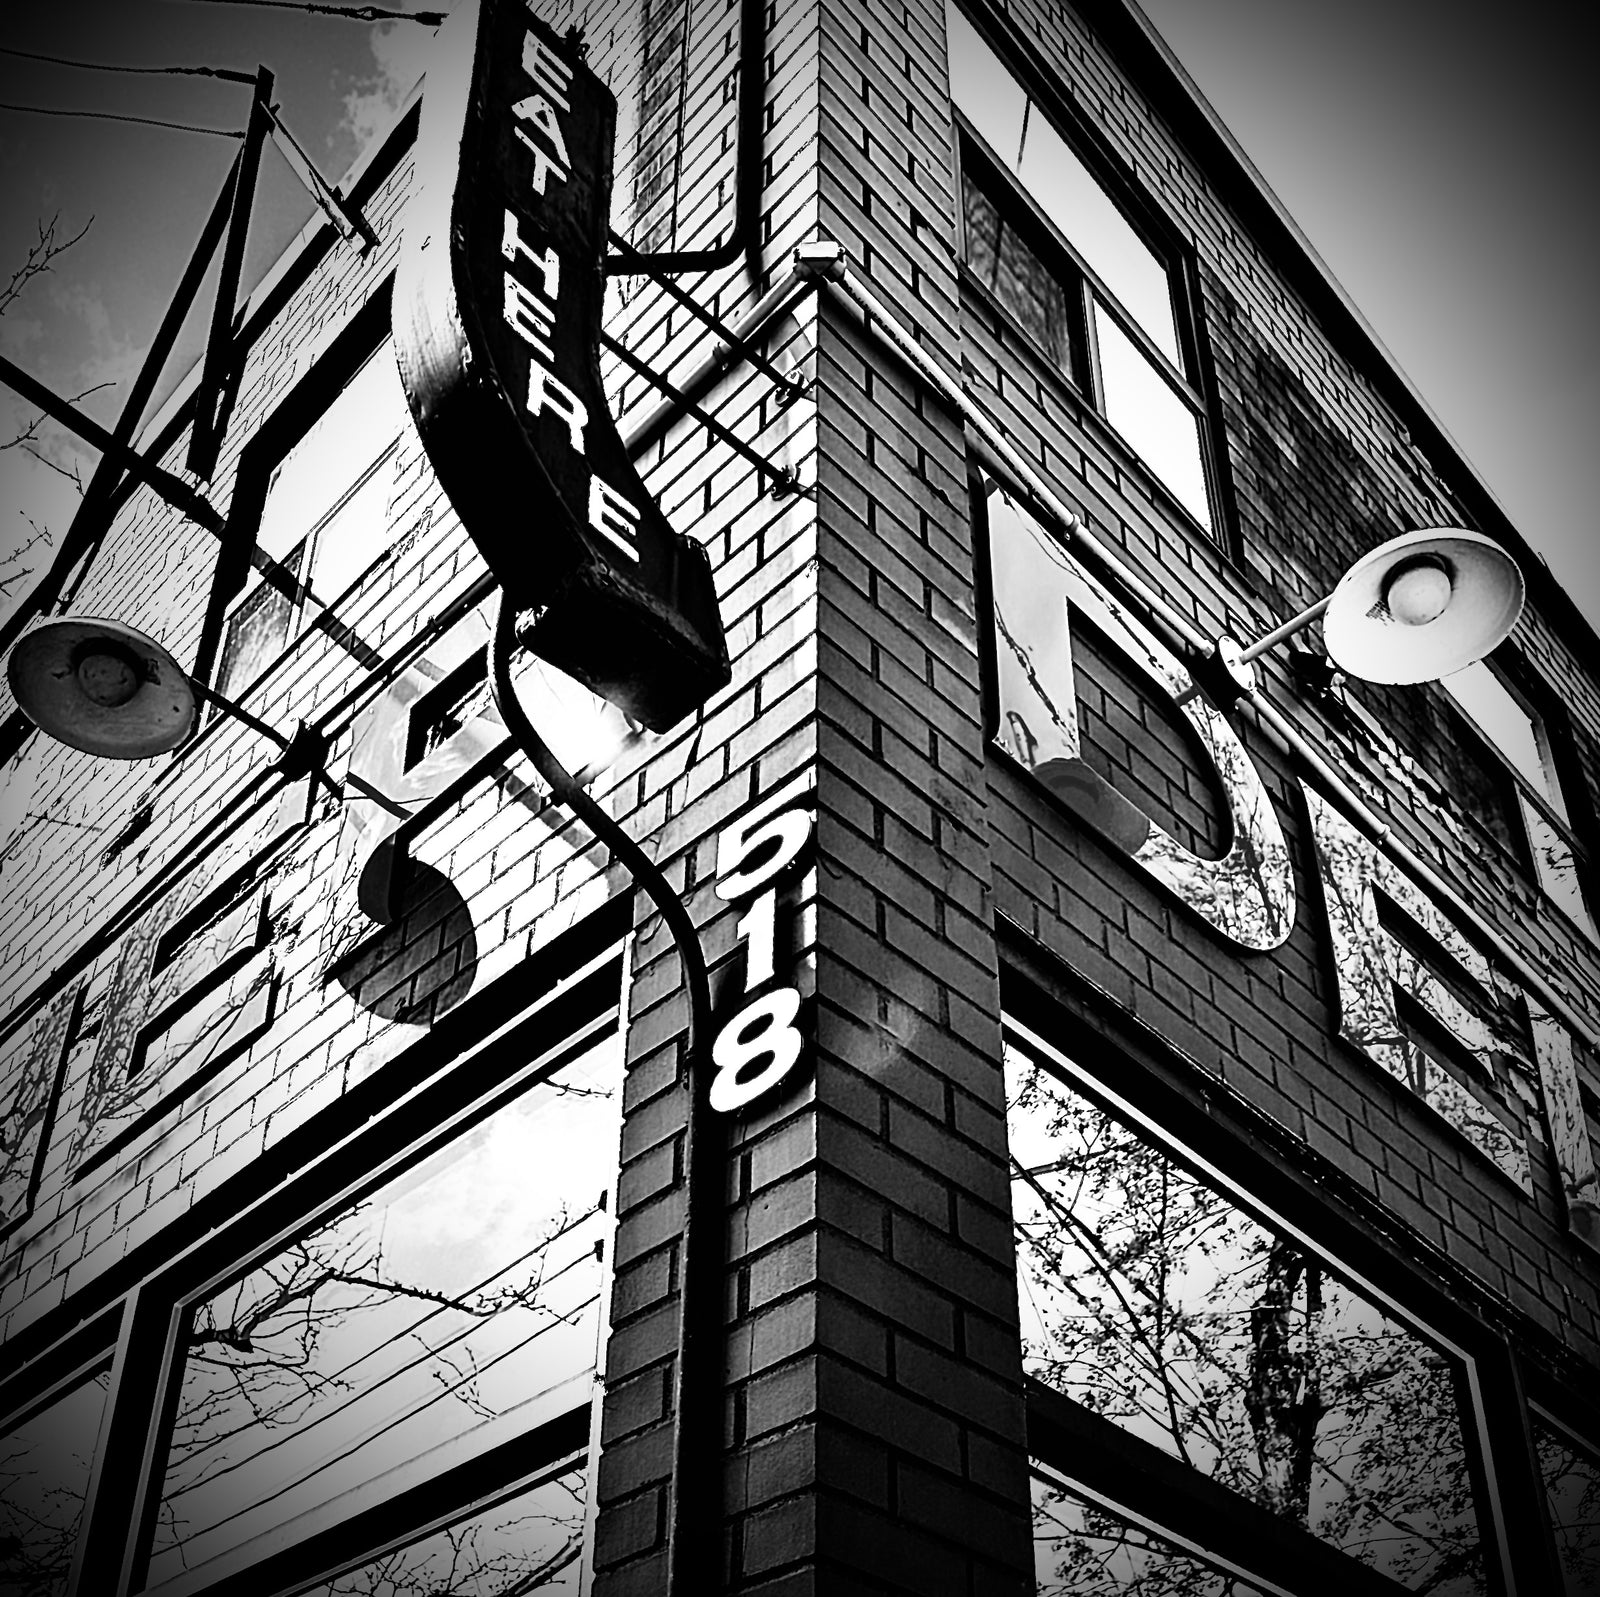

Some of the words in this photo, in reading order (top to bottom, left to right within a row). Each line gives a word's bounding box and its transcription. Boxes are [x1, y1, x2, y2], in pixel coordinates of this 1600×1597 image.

[511, 28, 574, 197] EAT
[502, 207, 641, 563] HERE
[709, 765, 812, 1113] 518
